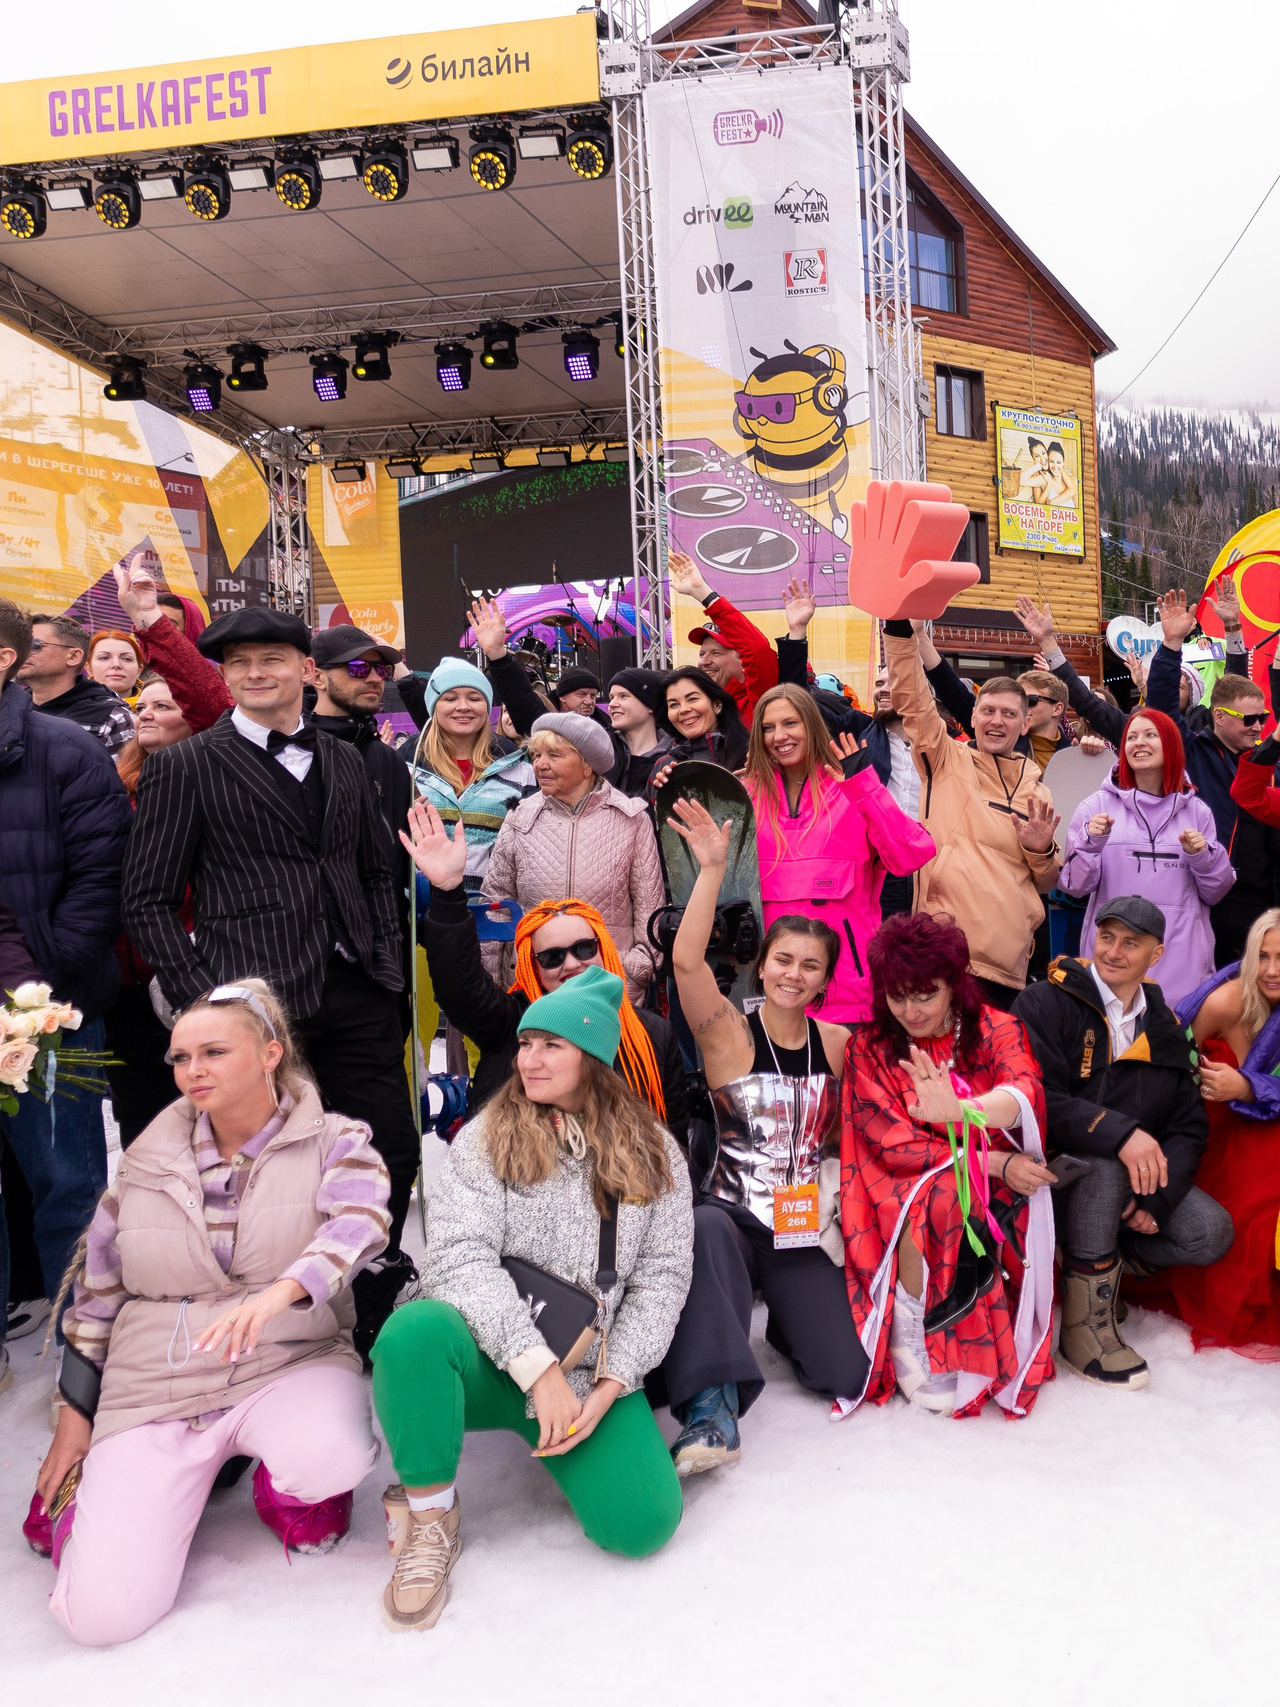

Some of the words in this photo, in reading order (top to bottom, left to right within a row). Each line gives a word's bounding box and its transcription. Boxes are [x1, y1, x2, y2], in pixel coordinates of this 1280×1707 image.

[421, 47, 531, 83] билайн
[48, 66, 273, 137] GRELKAFEST
[719, 113, 753, 129] GRELKA
[720, 129, 743, 142] FEST
[683, 201, 754, 226] drivee
[774, 201, 828, 216] MOUNTAIN
[804, 212, 830, 224] MAN
[787, 286, 827, 296] ROSTIC'S
[1001, 410, 1075, 429] КРУГЛОСУТОЧНО
[27, 456, 107, 479] ШЕРЕГЕШЕ
[111, 471, 143, 487] УЖЕ
[164, 482, 194, 496] ЛЕТ!
[0, 505, 46, 518] артирник
[1003, 502, 1046, 519] ВОСЕМЬ
[1051, 509, 1078, 523] БАНЬ
[1020, 518, 1035, 530] НА
[1037, 520, 1063, 533] ГОРЕ
[216, 579, 246, 592] ТЫ
[349, 607, 377, 619] Cola
[781, 1200, 813, 1214] AYS!
[787, 1217, 807, 1227] 266
